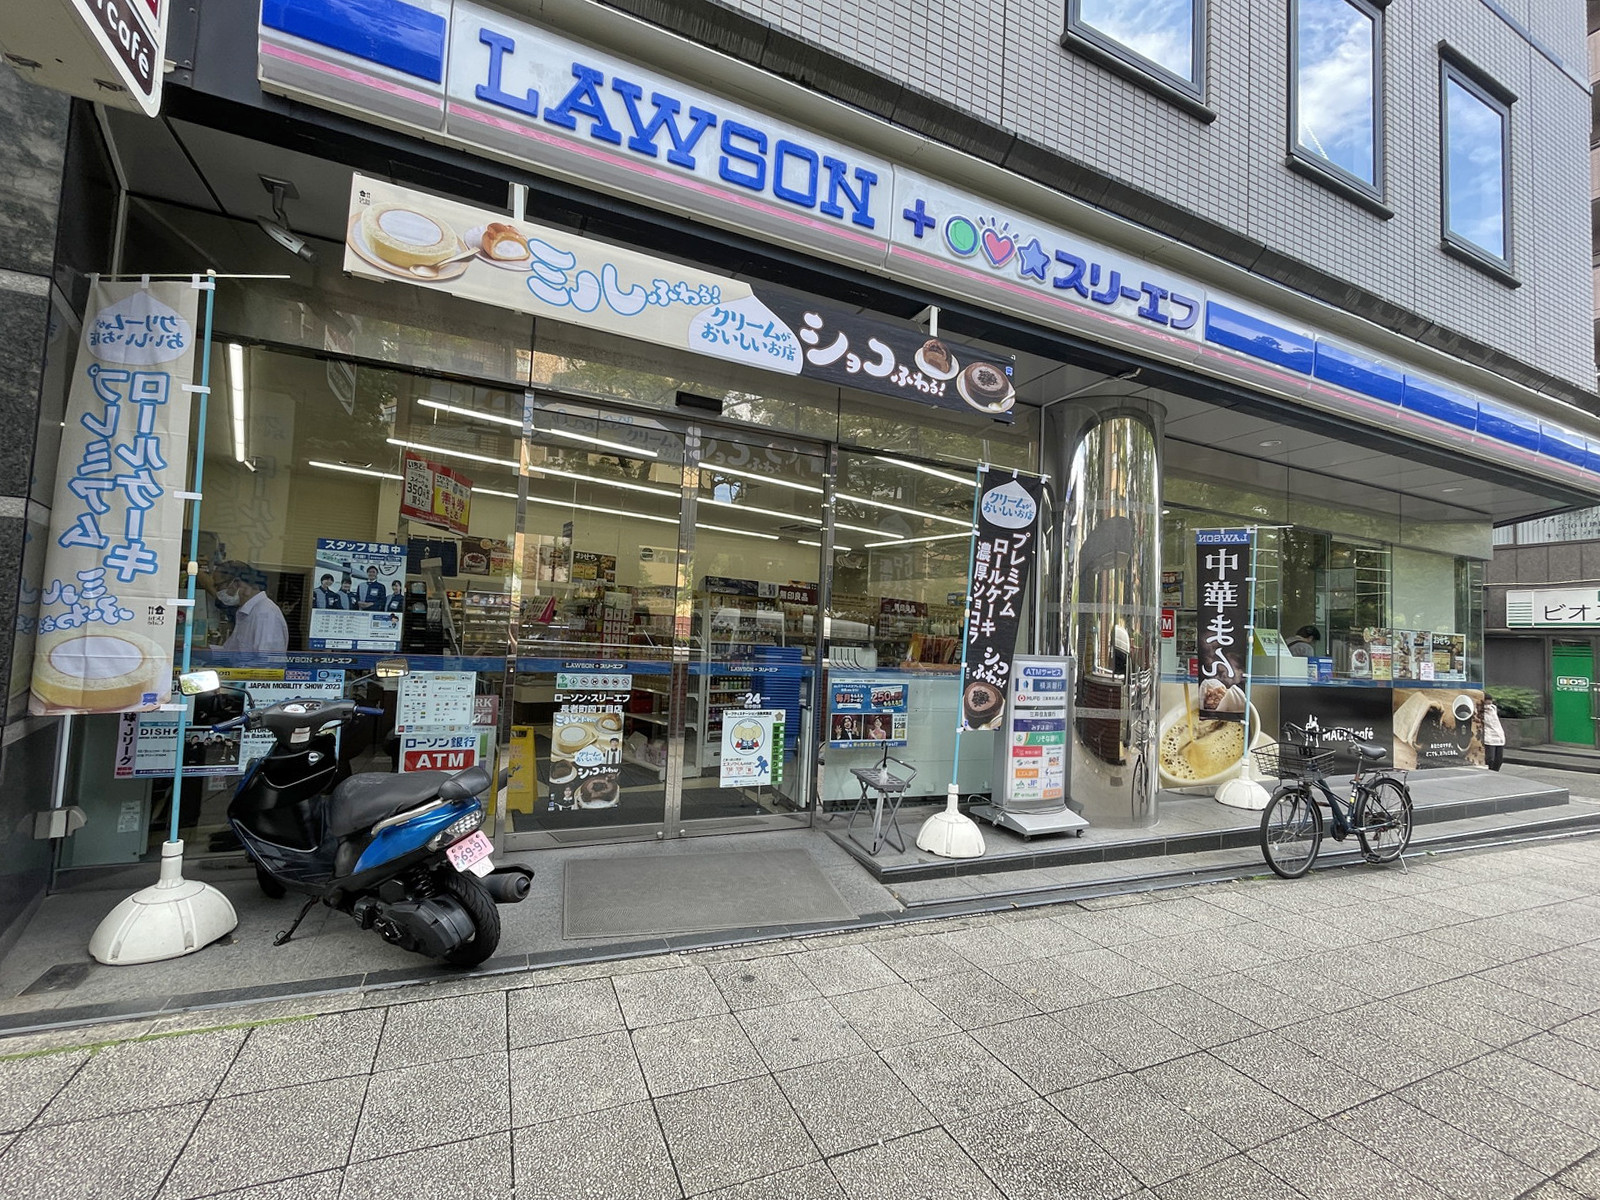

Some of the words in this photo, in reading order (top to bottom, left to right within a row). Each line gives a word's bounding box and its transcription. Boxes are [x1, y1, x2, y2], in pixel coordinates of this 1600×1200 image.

[107, 1, 149, 79] café
[475, 27, 878, 229] LAWSON
[1052, 249, 1200, 330] スリーエフ
[711, 307, 792, 341] クリームが
[701, 322, 797, 361] おいしいお店
[983, 501, 1034, 520] おいしいお店
[325, 540, 401, 554] スタッフ募集中
[980, 538, 1009, 637] ロールケーキ
[1000, 532, 1030, 617] プレミアム
[969, 541, 992, 644] 濃厚ショコラ
[1025, 668, 1062, 676] ATMサービス
[475, 698, 492, 707] RK
[554, 693, 630, 703] ローソン・スリーエフ
[745, 692, 761, 704] 24
[406, 737, 476, 749] ローソン銀行
[416, 753, 465, 768] ATM
